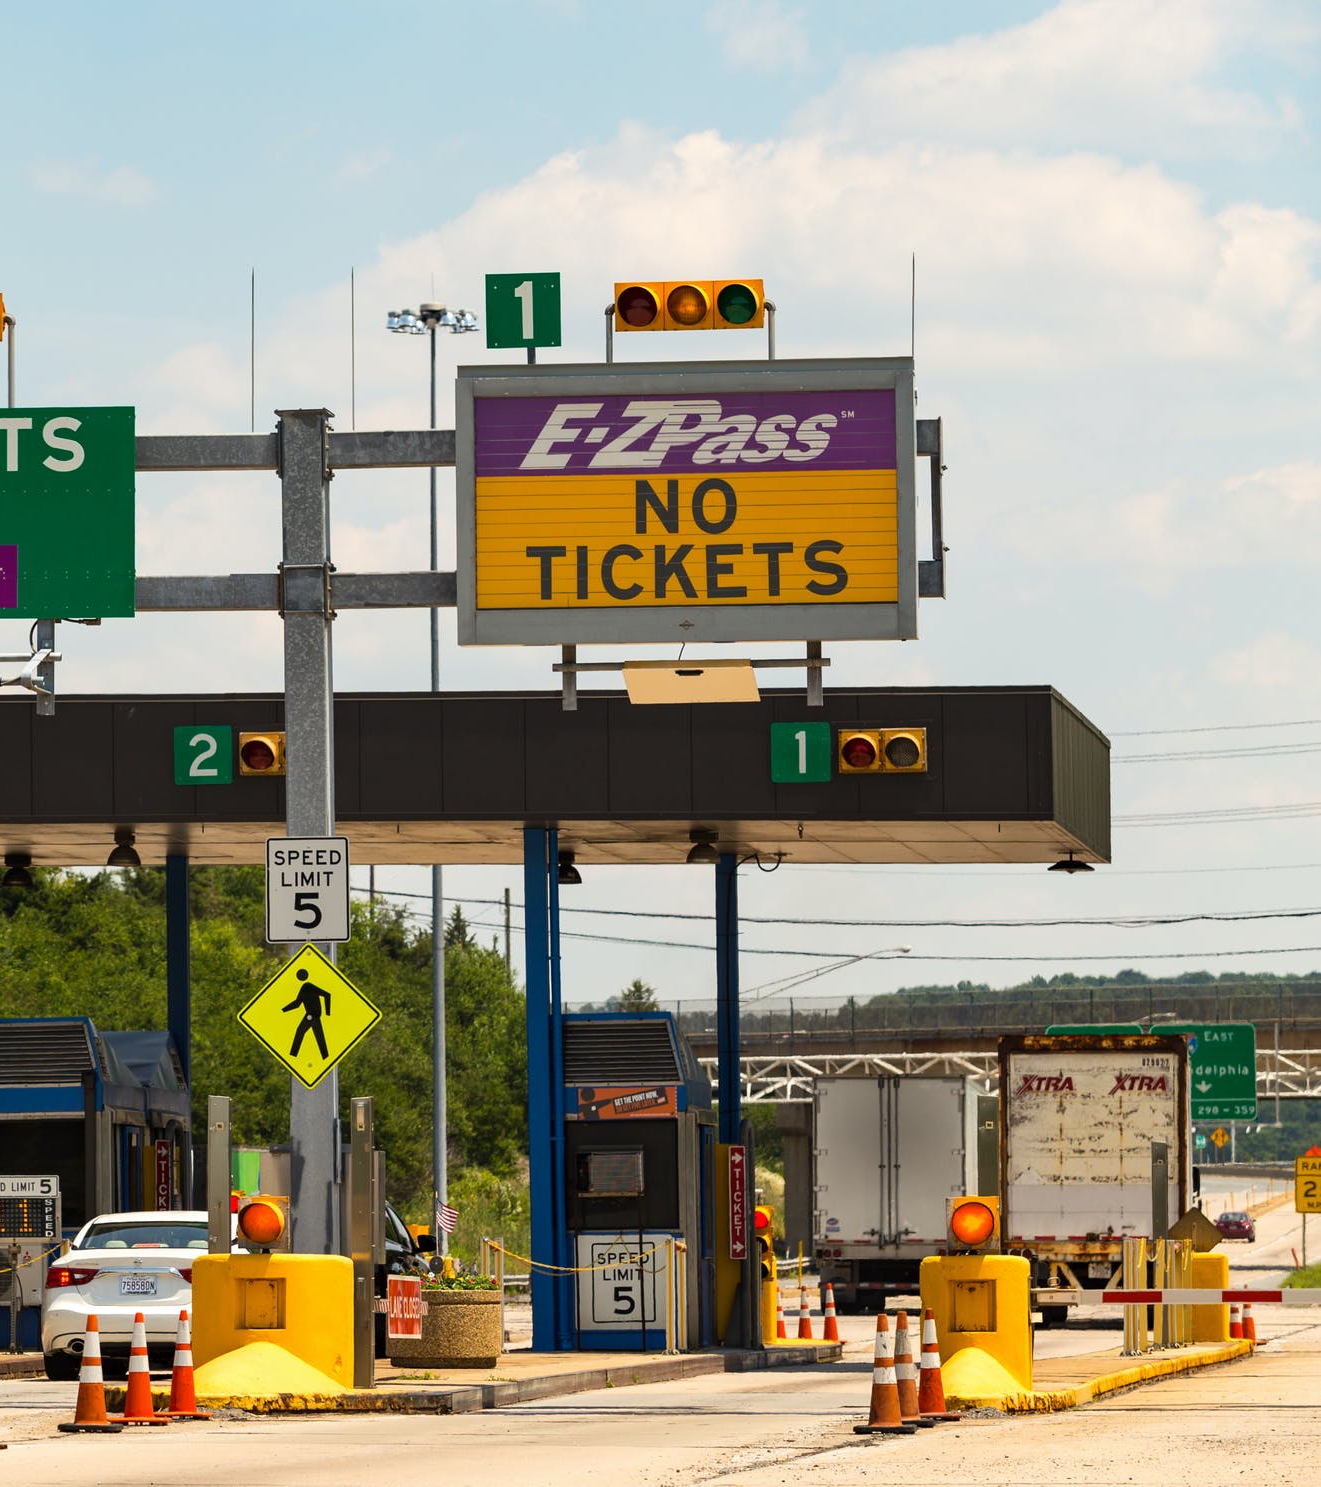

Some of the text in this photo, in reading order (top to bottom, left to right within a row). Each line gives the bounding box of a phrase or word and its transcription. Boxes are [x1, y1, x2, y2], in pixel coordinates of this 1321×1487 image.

[514, 281, 534, 339] 1
[635, 477, 738, 535] NO
[526, 539, 849, 600] TICKETS
[188, 733, 218, 777] 2
[794, 730, 807, 774] 1
[274, 850, 341, 866] SPEED
[281, 871, 334, 887] LIMIT
[294, 892, 322, 929] 5
[1204, 1031, 1234, 1042] EAST
[1195, 1064, 1249, 1077] delphia
[1016, 1075, 1074, 1096] XTRA
[1109, 1074, 1167, 1096] XTRA
[1302, 1161, 1321, 1170] RA
[11, 1182, 36, 1192] LIMIT
[40, 1179, 52, 1194] 5
[1304, 1181, 1320, 1197] 2
[44, 1199, 54, 1237] SPEED
[597, 1252, 649, 1265] SPEED
[603, 1269, 642, 1281] LIMIT
[614, 1286, 635, 1315] 5
